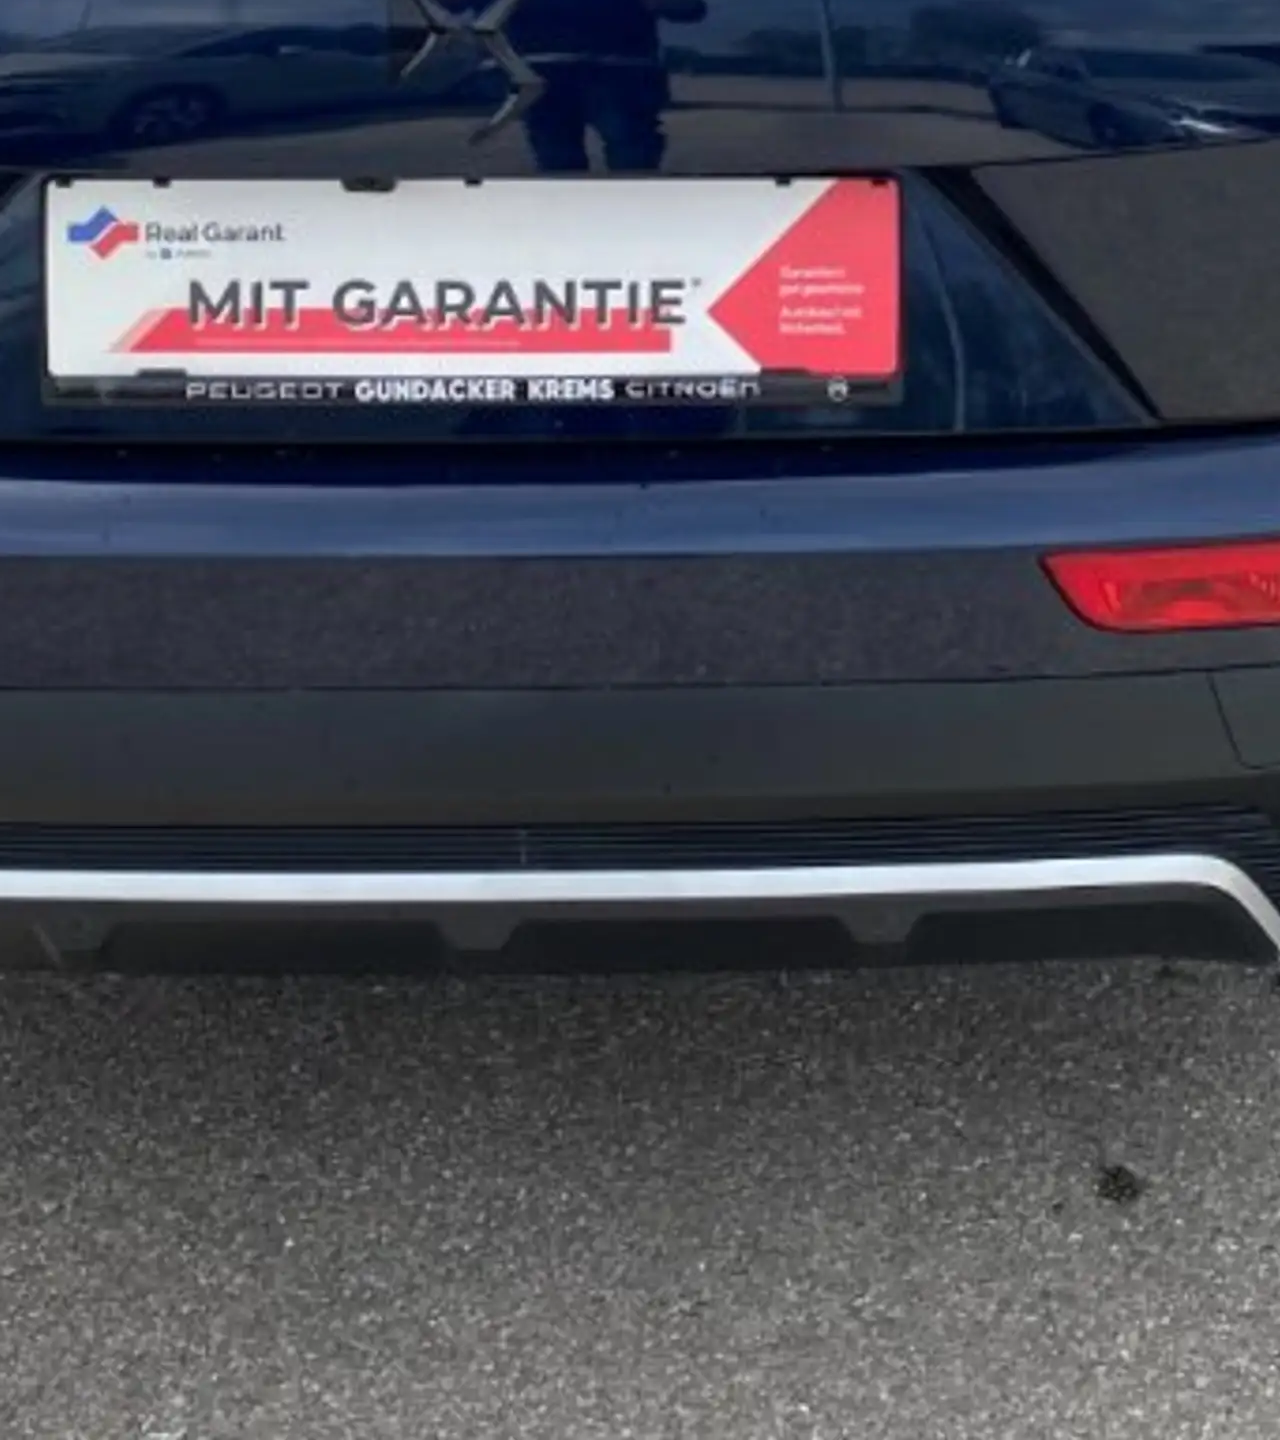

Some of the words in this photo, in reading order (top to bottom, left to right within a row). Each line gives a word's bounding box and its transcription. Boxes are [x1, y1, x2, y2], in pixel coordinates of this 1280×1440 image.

[145, 221, 199, 242] Real
[202, 221, 284, 242] Garant
[188, 280, 310, 325] MIT
[332, 279, 687, 325] GARANTIE
[185, 381, 344, 401] PEUGEOT
[353, 379, 516, 402] GUNDACKER
[527, 379, 616, 401] KREMS
